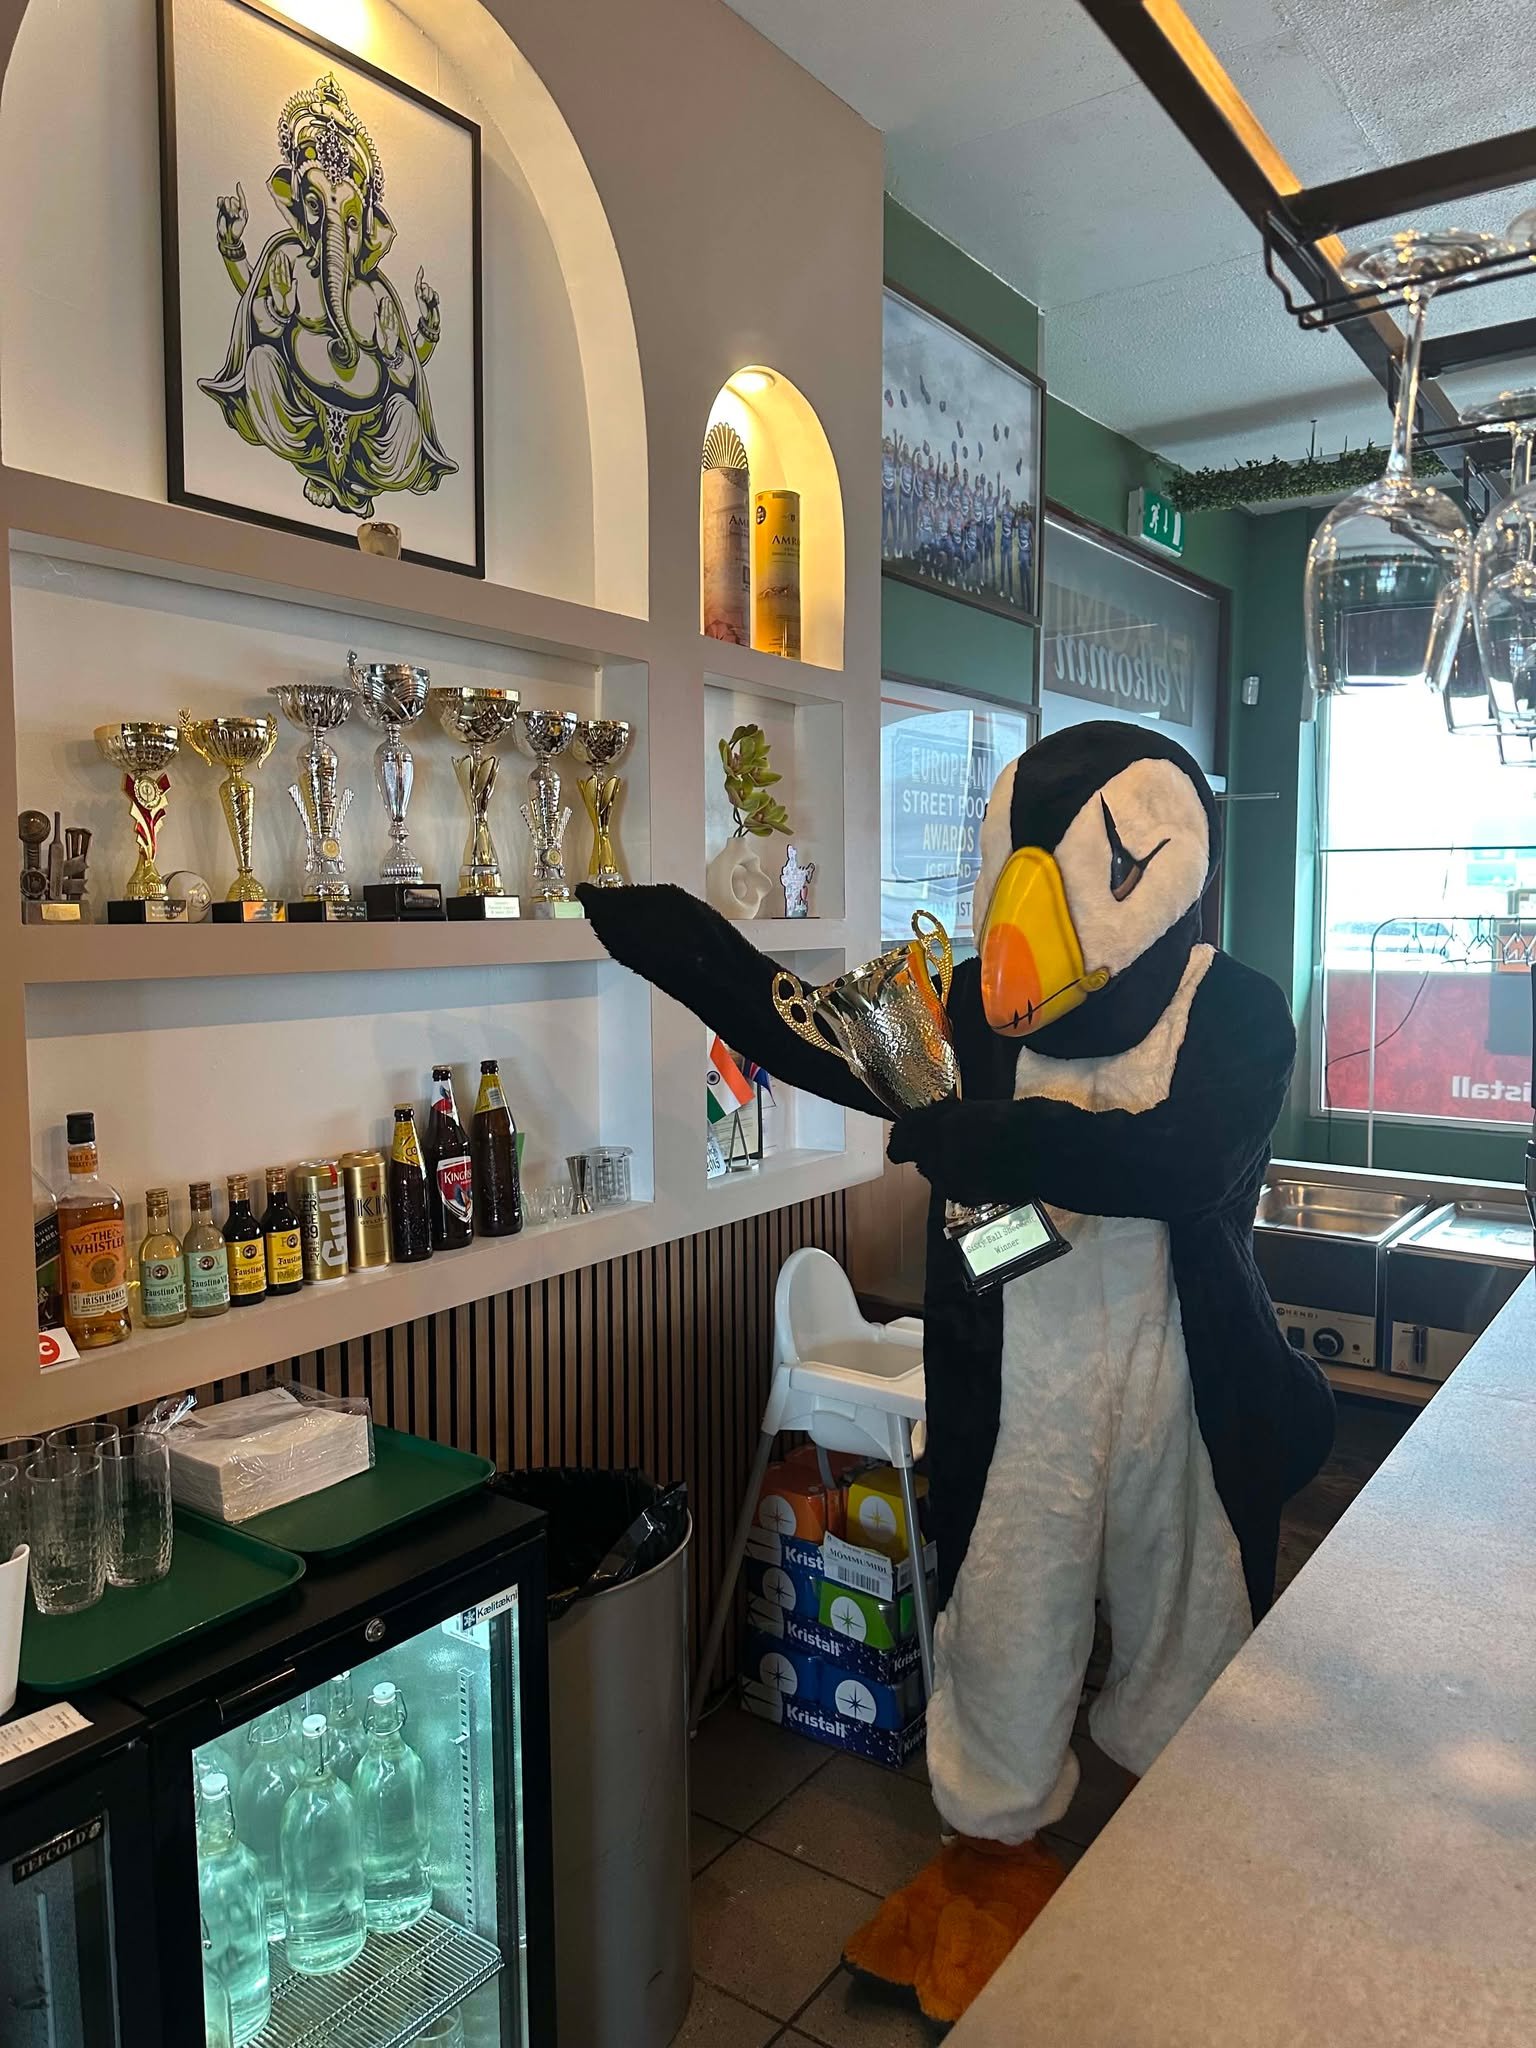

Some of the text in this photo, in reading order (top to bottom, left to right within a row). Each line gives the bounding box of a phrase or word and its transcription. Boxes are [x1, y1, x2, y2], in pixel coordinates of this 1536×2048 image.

[911, 747, 986, 790] EUROPEAN
[903, 789, 955, 817] STREET
[923, 823, 975, 853] AWARDS
[926, 860, 972, 879] ICELAND
[930, 900, 971, 917] INALIST
[91, 1230, 112, 1242] THE
[986, 1231, 1003, 1244] Ball
[994, 1237, 1020, 1255] Winner
[191, 1277, 221, 1288] Faustino
[82, 1294, 105, 1306] IRISH
[105, 1288, 125, 1301] HONEY
[144, 1287, 175, 1297] Faustino
[1285, 1308, 1319, 1320] HENDI
[786, 1619, 841, 1657] Kristall
[786, 1703, 848, 1738] Kristall
[17, 1830, 86, 1879] TEFCOLD
